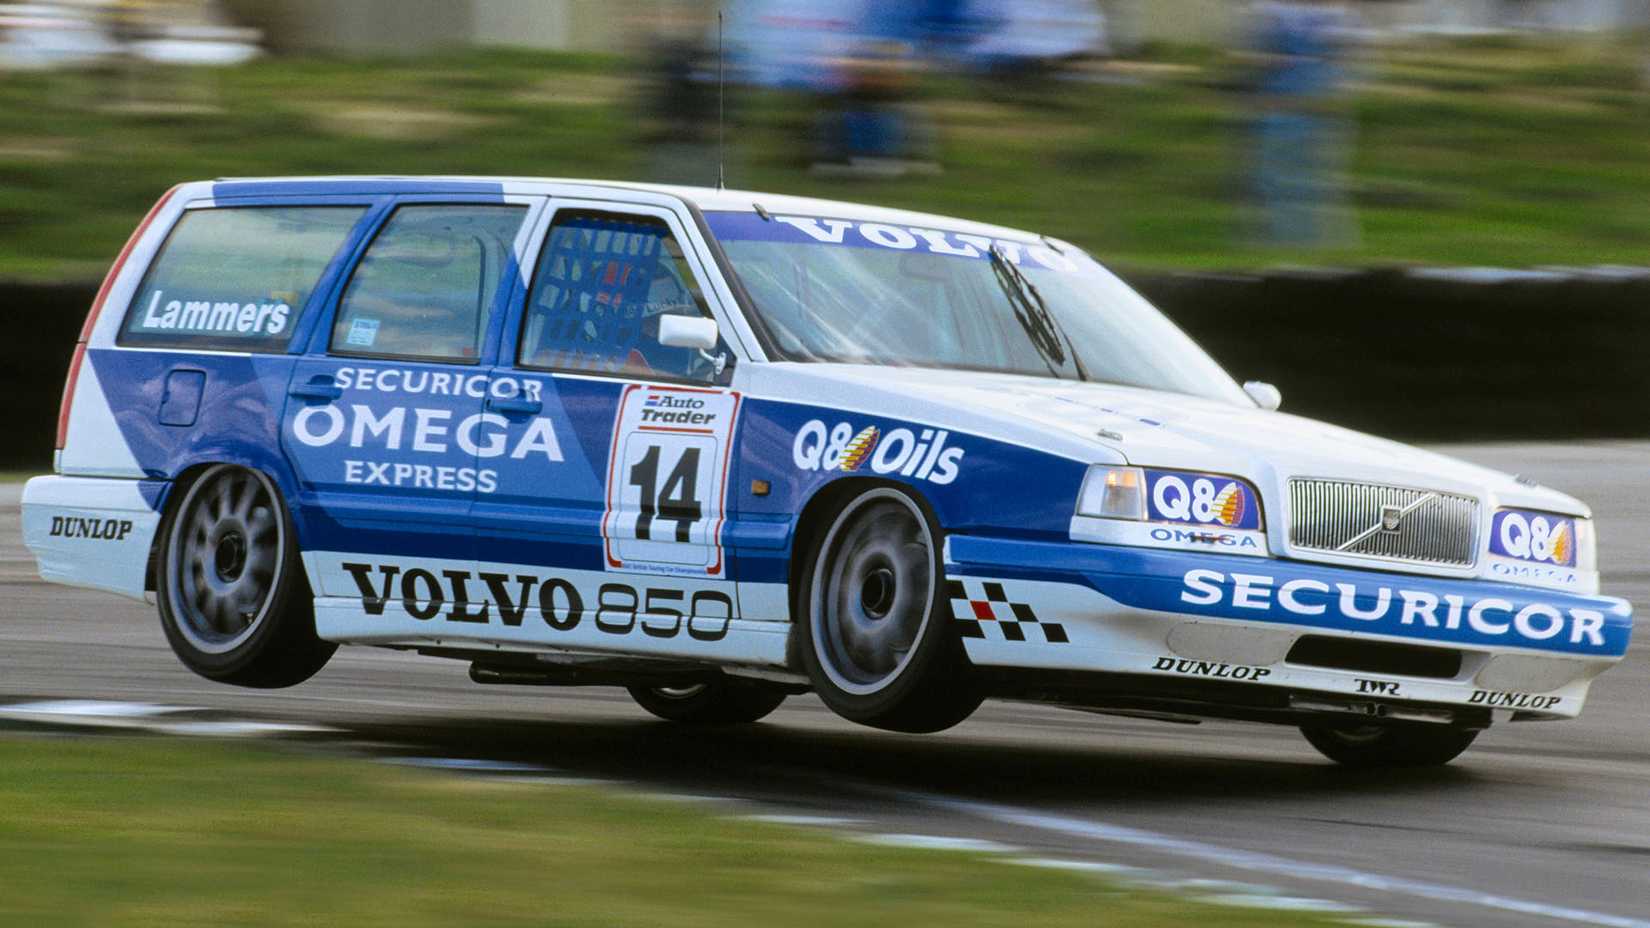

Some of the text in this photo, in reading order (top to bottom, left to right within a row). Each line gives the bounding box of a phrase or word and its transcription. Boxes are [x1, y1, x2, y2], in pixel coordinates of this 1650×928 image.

[143, 290, 289, 335] Lammers
[334, 367, 543, 402] SECURICOR
[658, 395, 705, 409] Auto
[293, 404, 564, 462] OMEGA
[641, 408, 717, 425] Trader
[793, 419, 965, 486] Q8 Oils
[344, 460, 497, 493] EXPRESS
[629, 446, 702, 543] 14
[1153, 475, 1216, 522] Q8
[50, 516, 133, 541] DUNLOP
[1500, 512, 1552, 561] Q8
[342, 562, 733, 641] VOLVO 850
[1181, 569, 1606, 646] SECURICOR
[1152, 656, 1271, 682] DUNLOP
[1355, 678, 1400, 697] TWR
[1467, 689, 1561, 710] DUNLOP
